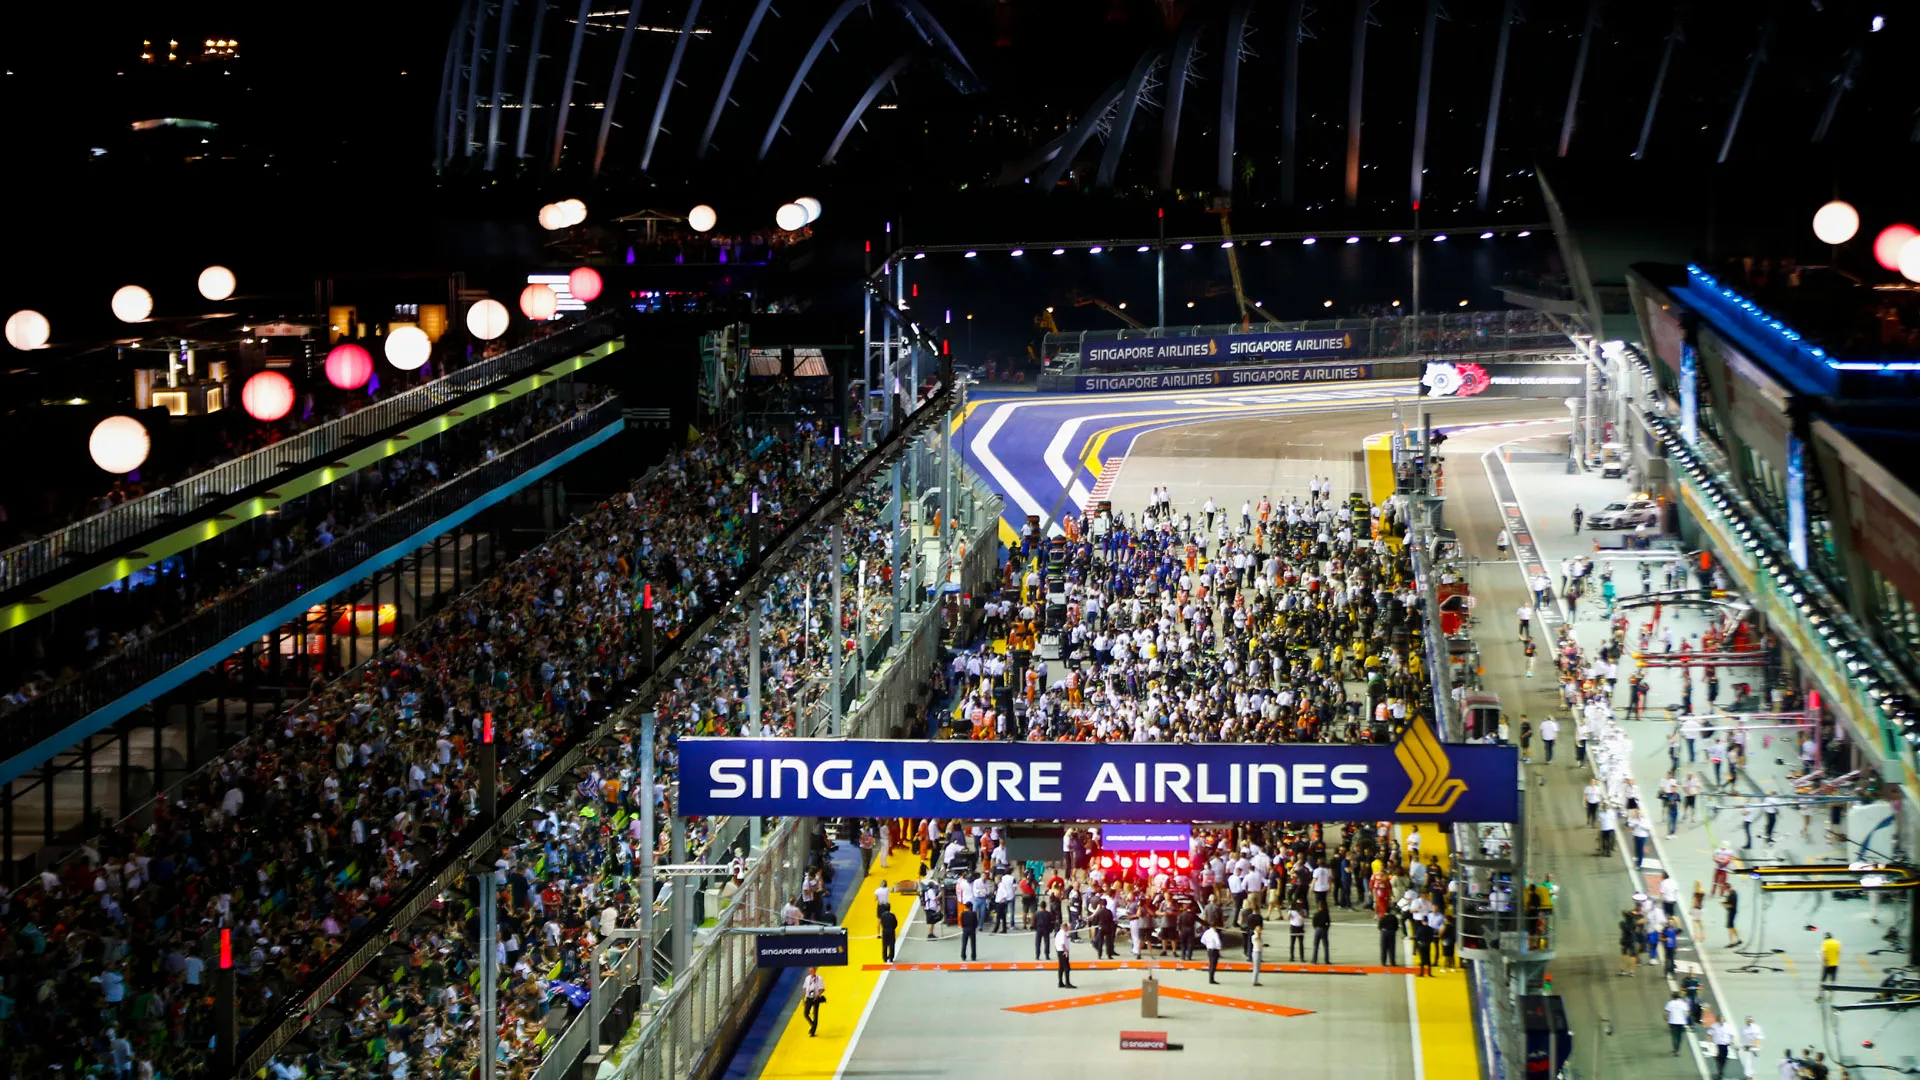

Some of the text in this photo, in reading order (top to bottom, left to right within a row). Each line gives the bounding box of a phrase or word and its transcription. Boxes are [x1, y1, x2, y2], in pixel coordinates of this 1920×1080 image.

[1089, 343, 1209, 361] SINGAPORE AIRLINES
[1229, 337, 1344, 354] SINGAPORE AIRLINES
[1085, 373, 1212, 391] SINGAPORE AIRLINES
[1232, 366, 1358, 383] SINGAPORE AIRLINES
[709, 757, 1369, 805] SINGAPORE AIRLINES
